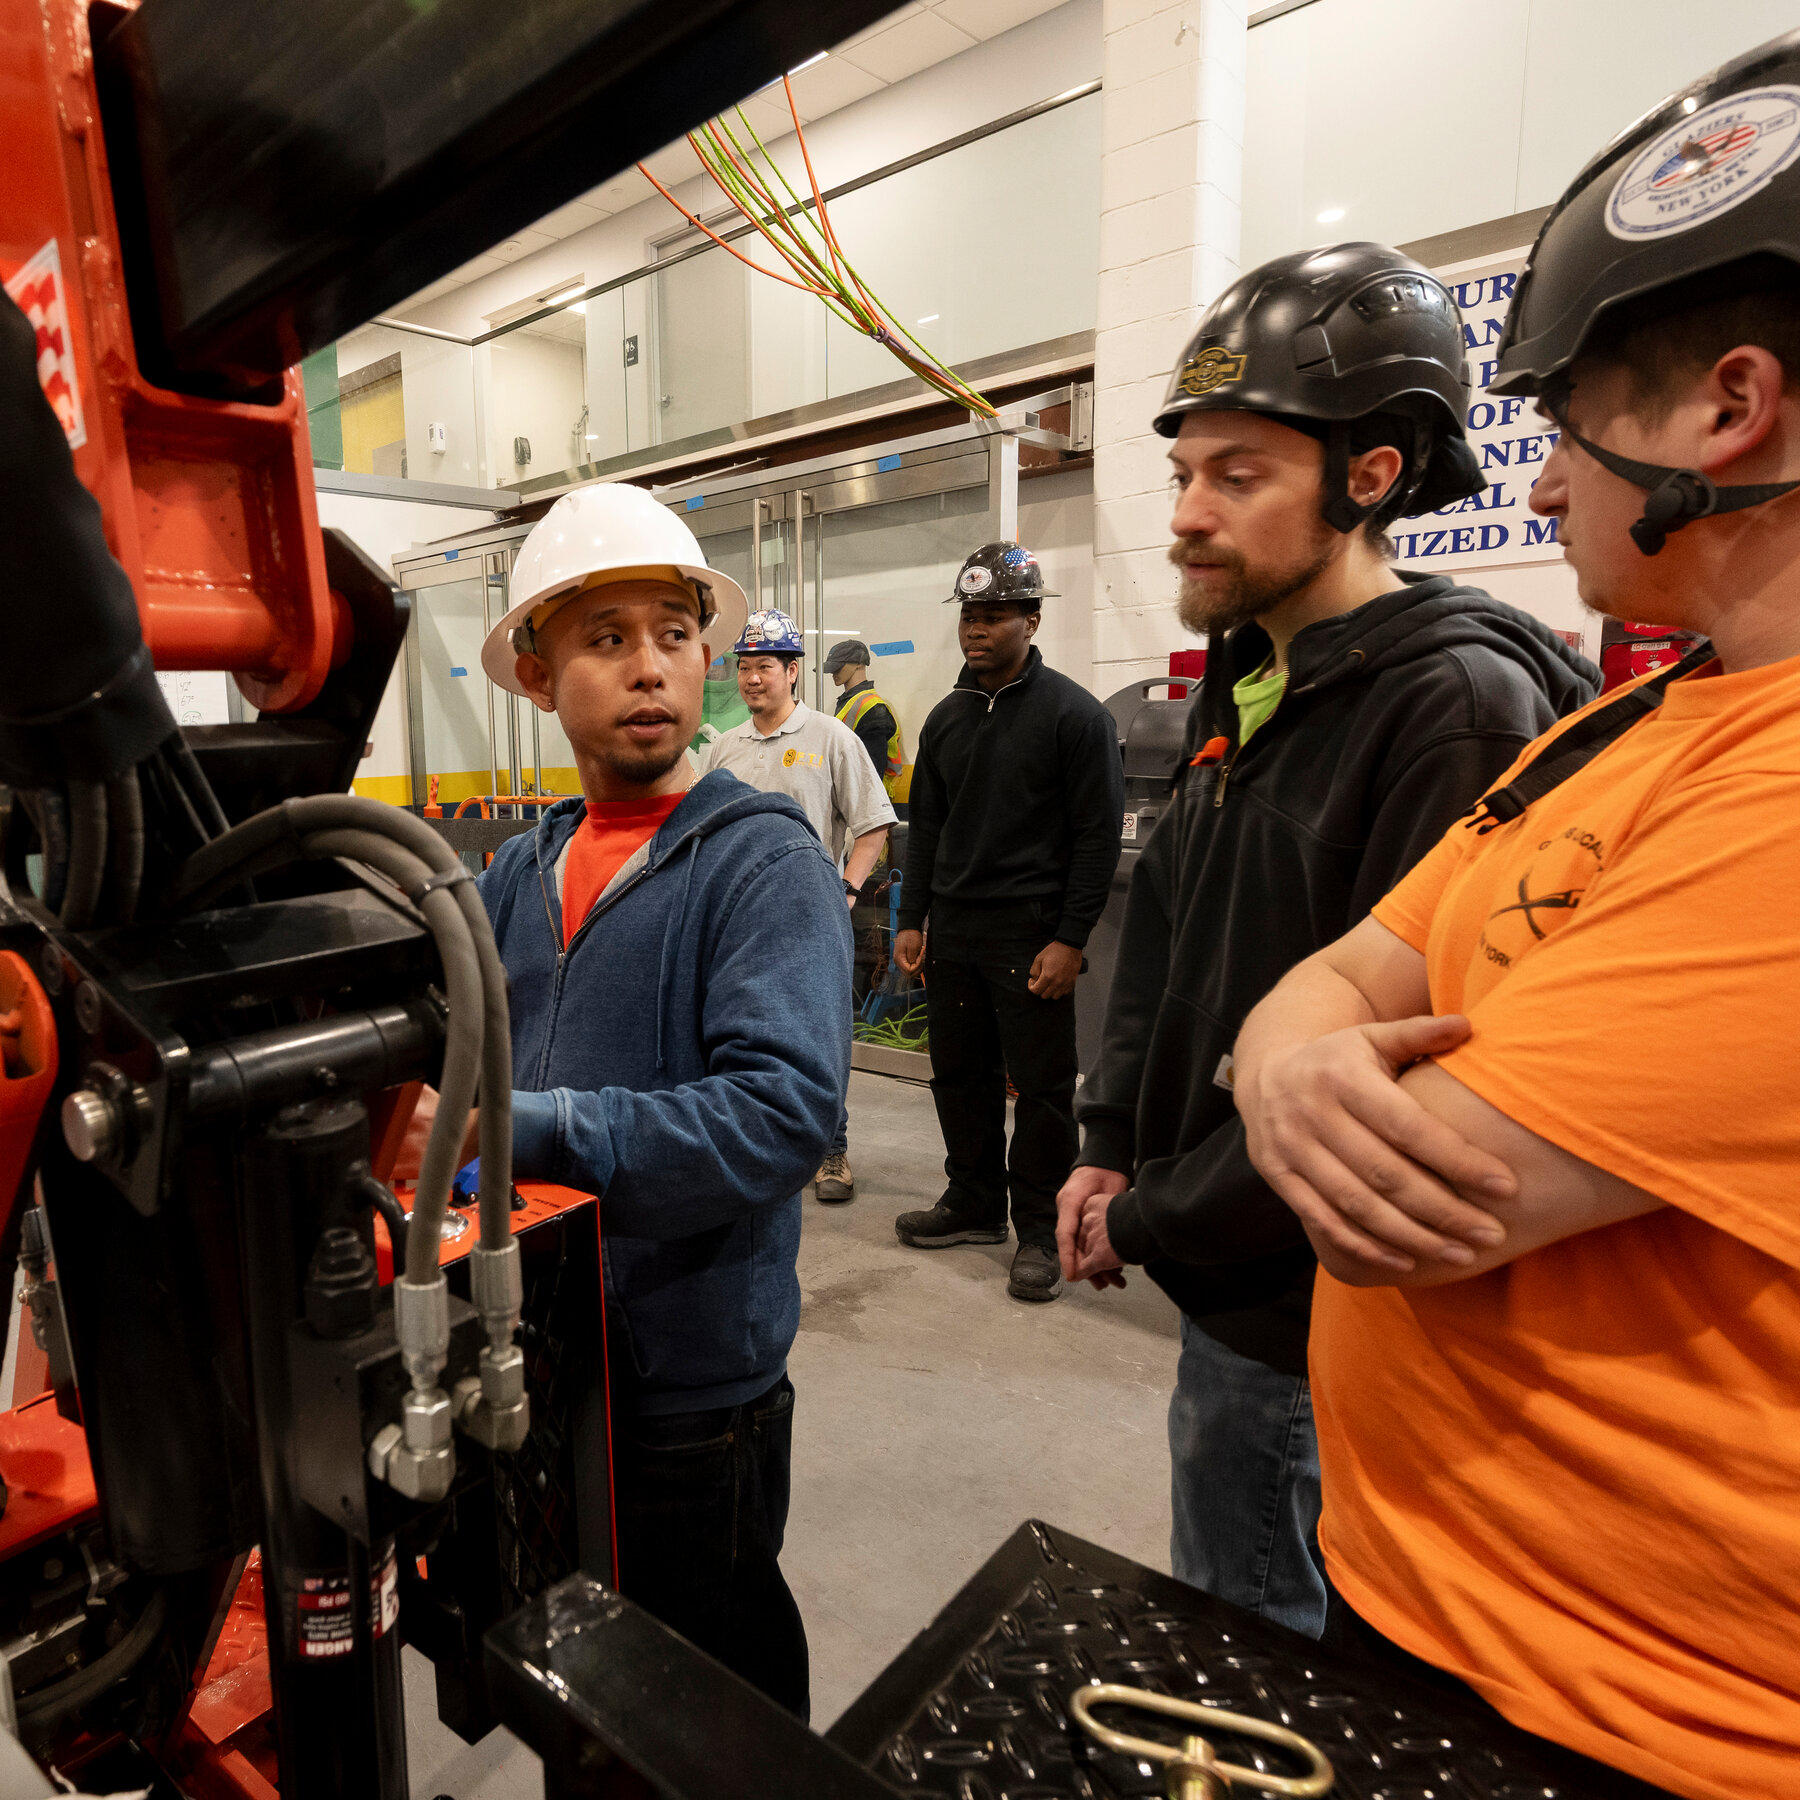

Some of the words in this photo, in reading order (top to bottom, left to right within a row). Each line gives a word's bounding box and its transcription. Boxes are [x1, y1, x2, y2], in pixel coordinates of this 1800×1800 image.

[1662, 112, 1745, 158] GLAZIERS
[1656, 196, 1691, 214] NEW
[1698, 167, 1750, 200] YORK
[1449, 273, 1517, 309] UR
[1467, 396, 1526, 431] OF
